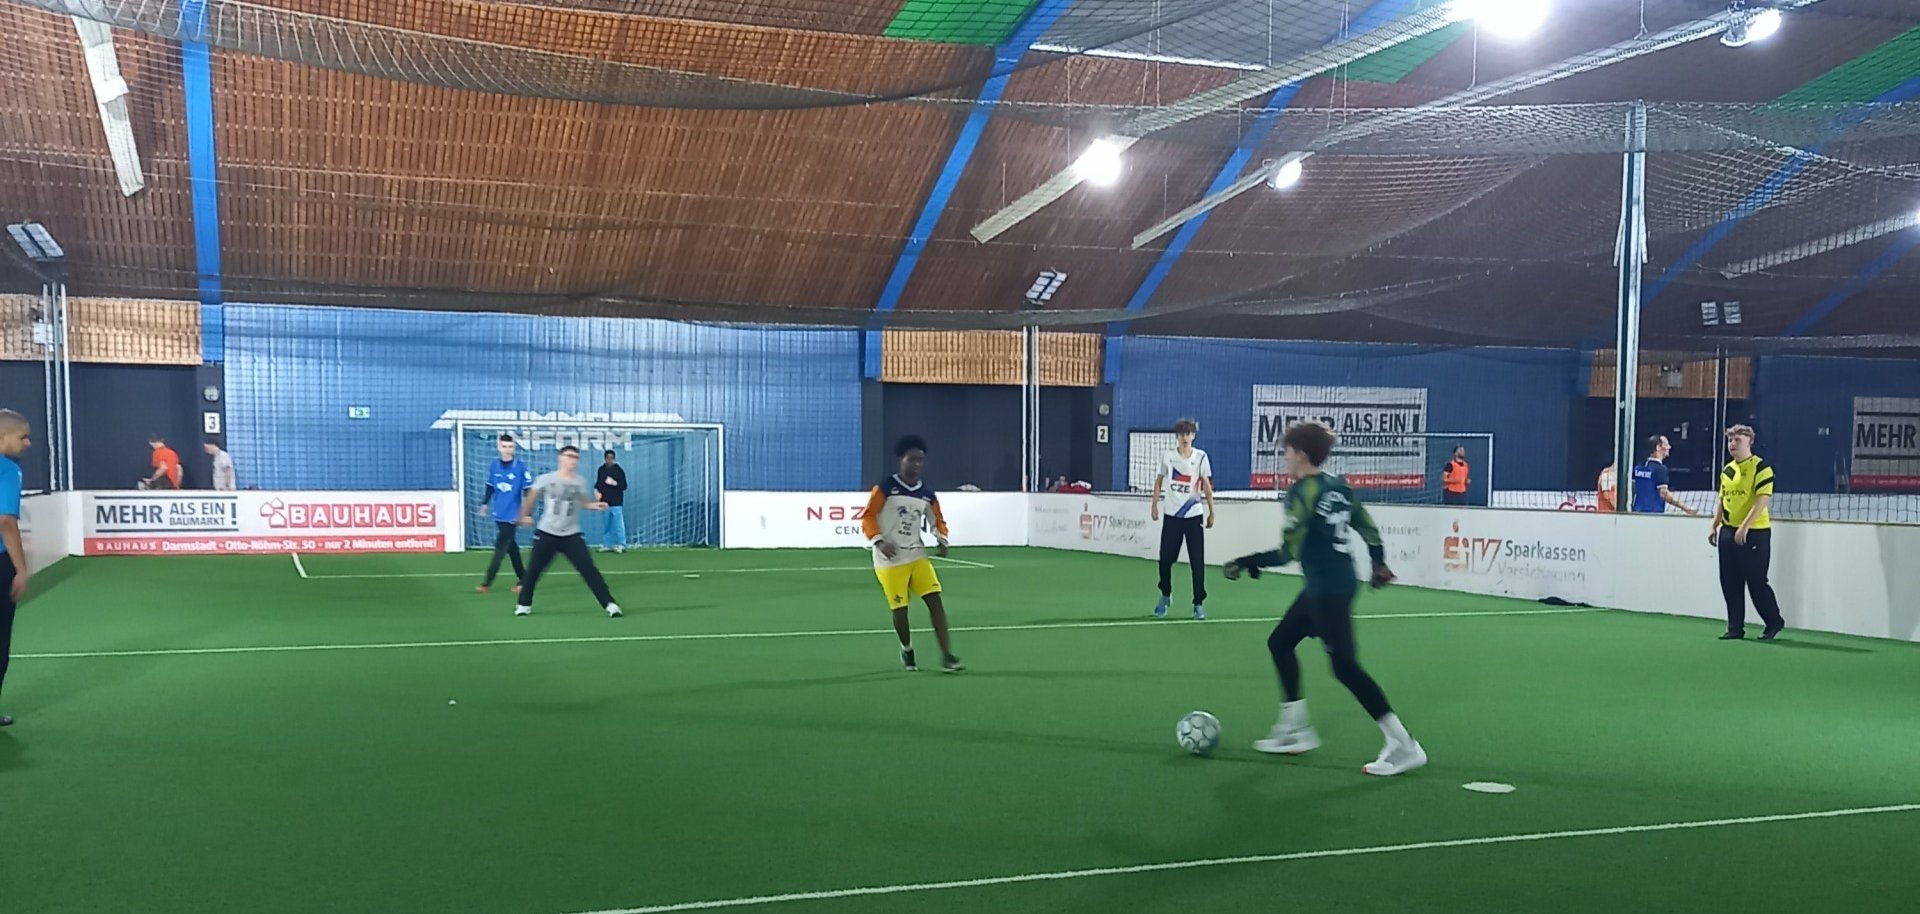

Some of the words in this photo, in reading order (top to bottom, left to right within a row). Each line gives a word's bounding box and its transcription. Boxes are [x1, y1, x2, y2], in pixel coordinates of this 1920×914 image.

[208, 416, 216, 429] 3
[1343, 413, 1373, 432] ALS
[1380, 414, 1407, 433] EIN
[1100, 428, 1106, 440] 2
[1856, 423, 1916, 448] MEHR
[1341, 435, 1406, 447] BAUMARKT
[1170, 483, 1190, 493] CZE
[96, 505, 163, 524] MEHR
[169, 502, 196, 515] ALS
[202, 502, 225, 515] EIN
[289, 504, 436, 527] BAUHAUS
[169, 516, 225, 526] BAUMARKT
[835, 526, 865, 535] CEN
[97, 541, 157, 550] BAUHAUS
[162, 540, 217, 550] Darmstadt
[302, 540, 315, 549] 50
[325, 541, 342, 549] nur
[343, 540, 351, 549] 2
[352, 539, 394, 549] Minuten
[395, 537, 438, 548] entfernt!
[1505, 540, 1586, 561] Sparkassen
